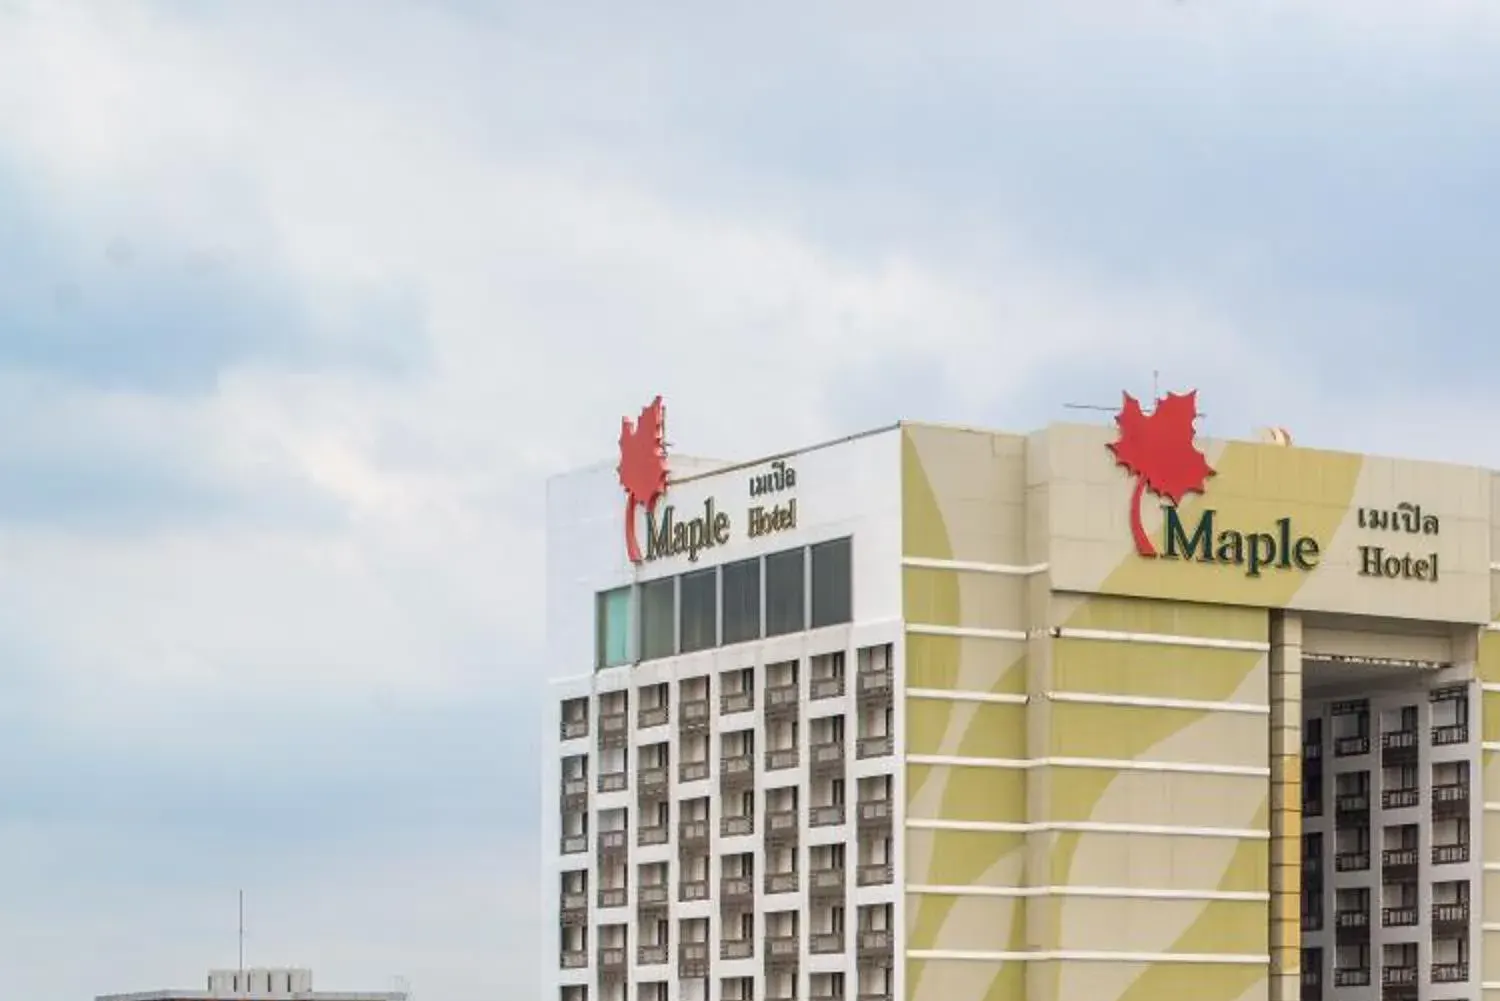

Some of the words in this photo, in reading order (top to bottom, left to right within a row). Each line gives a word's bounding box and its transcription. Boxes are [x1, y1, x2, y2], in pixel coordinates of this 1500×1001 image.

[749, 461, 797, 499] เมเปิล
[645, 496, 730, 561] Maple
[748, 498, 797, 538] Hotel
[1160, 504, 1320, 577] Maple
[1357, 545, 1439, 583] Hotel
[1357, 501, 1440, 535] เมเปิล
